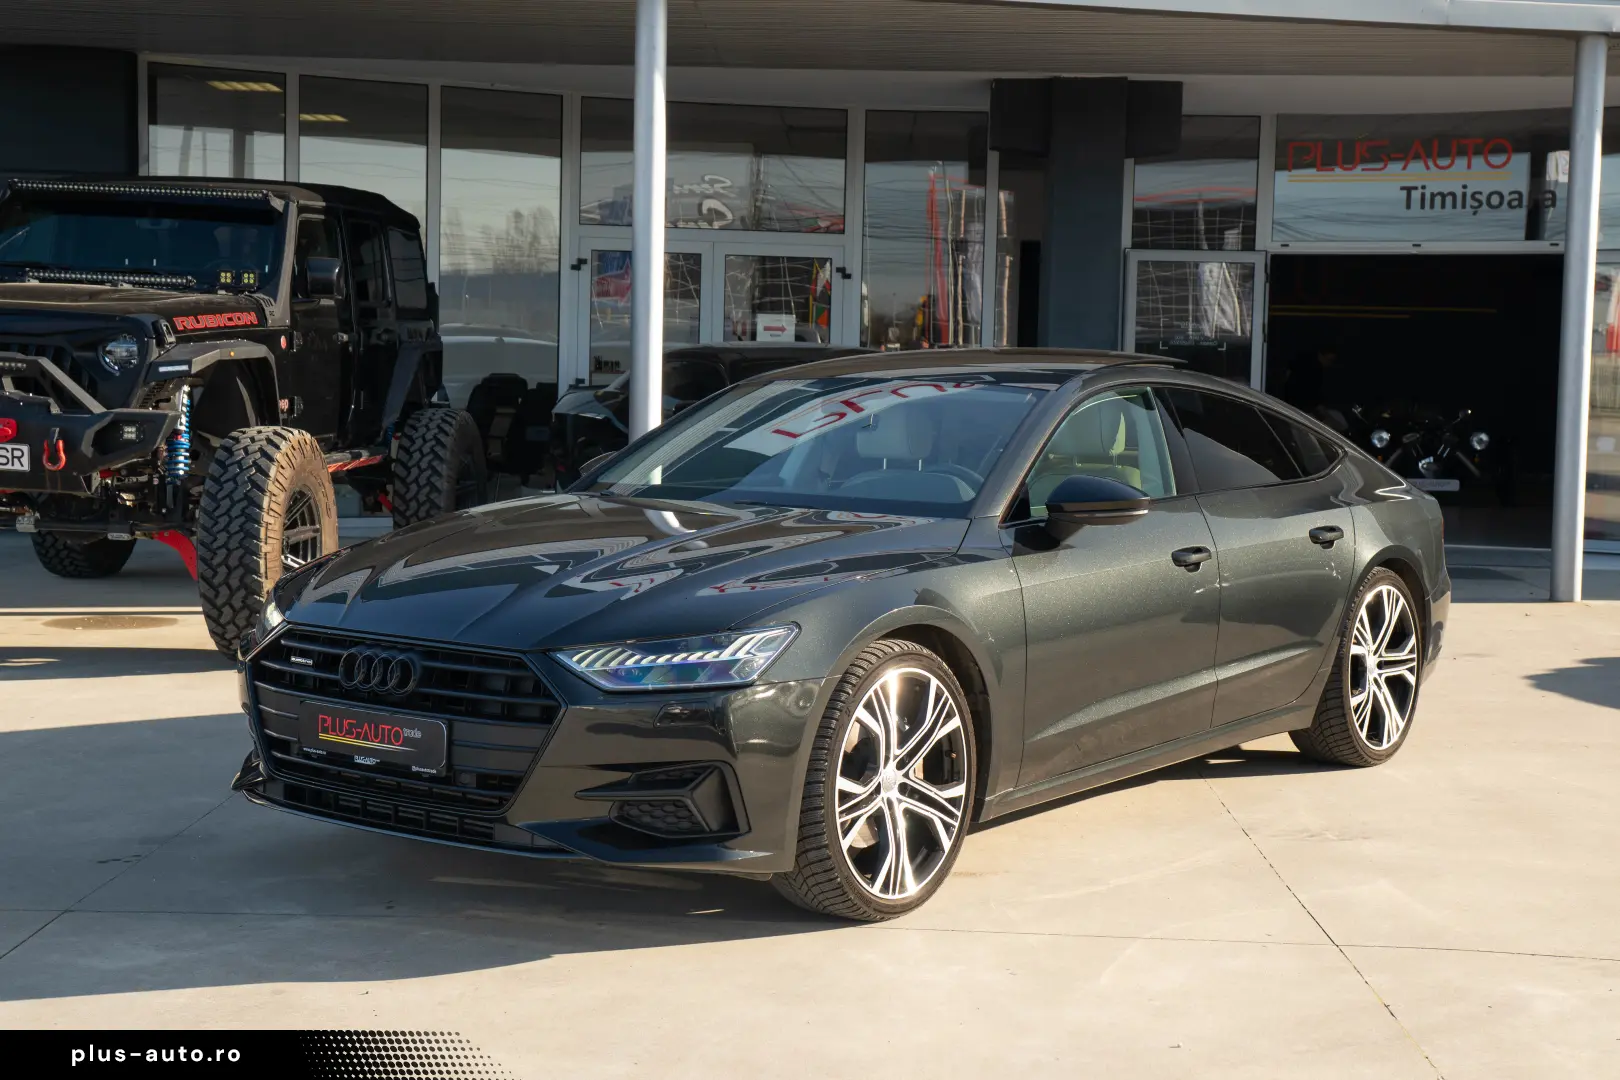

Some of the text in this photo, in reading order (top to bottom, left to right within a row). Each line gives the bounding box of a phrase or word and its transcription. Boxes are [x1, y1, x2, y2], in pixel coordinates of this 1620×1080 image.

[1287, 137, 1513, 172] PLUS-AUTO
[1399, 184, 1558, 216] Timișoaa
[173, 312, 259, 331] RUBICON
[318, 714, 404, 746] PLUS-AUTO
